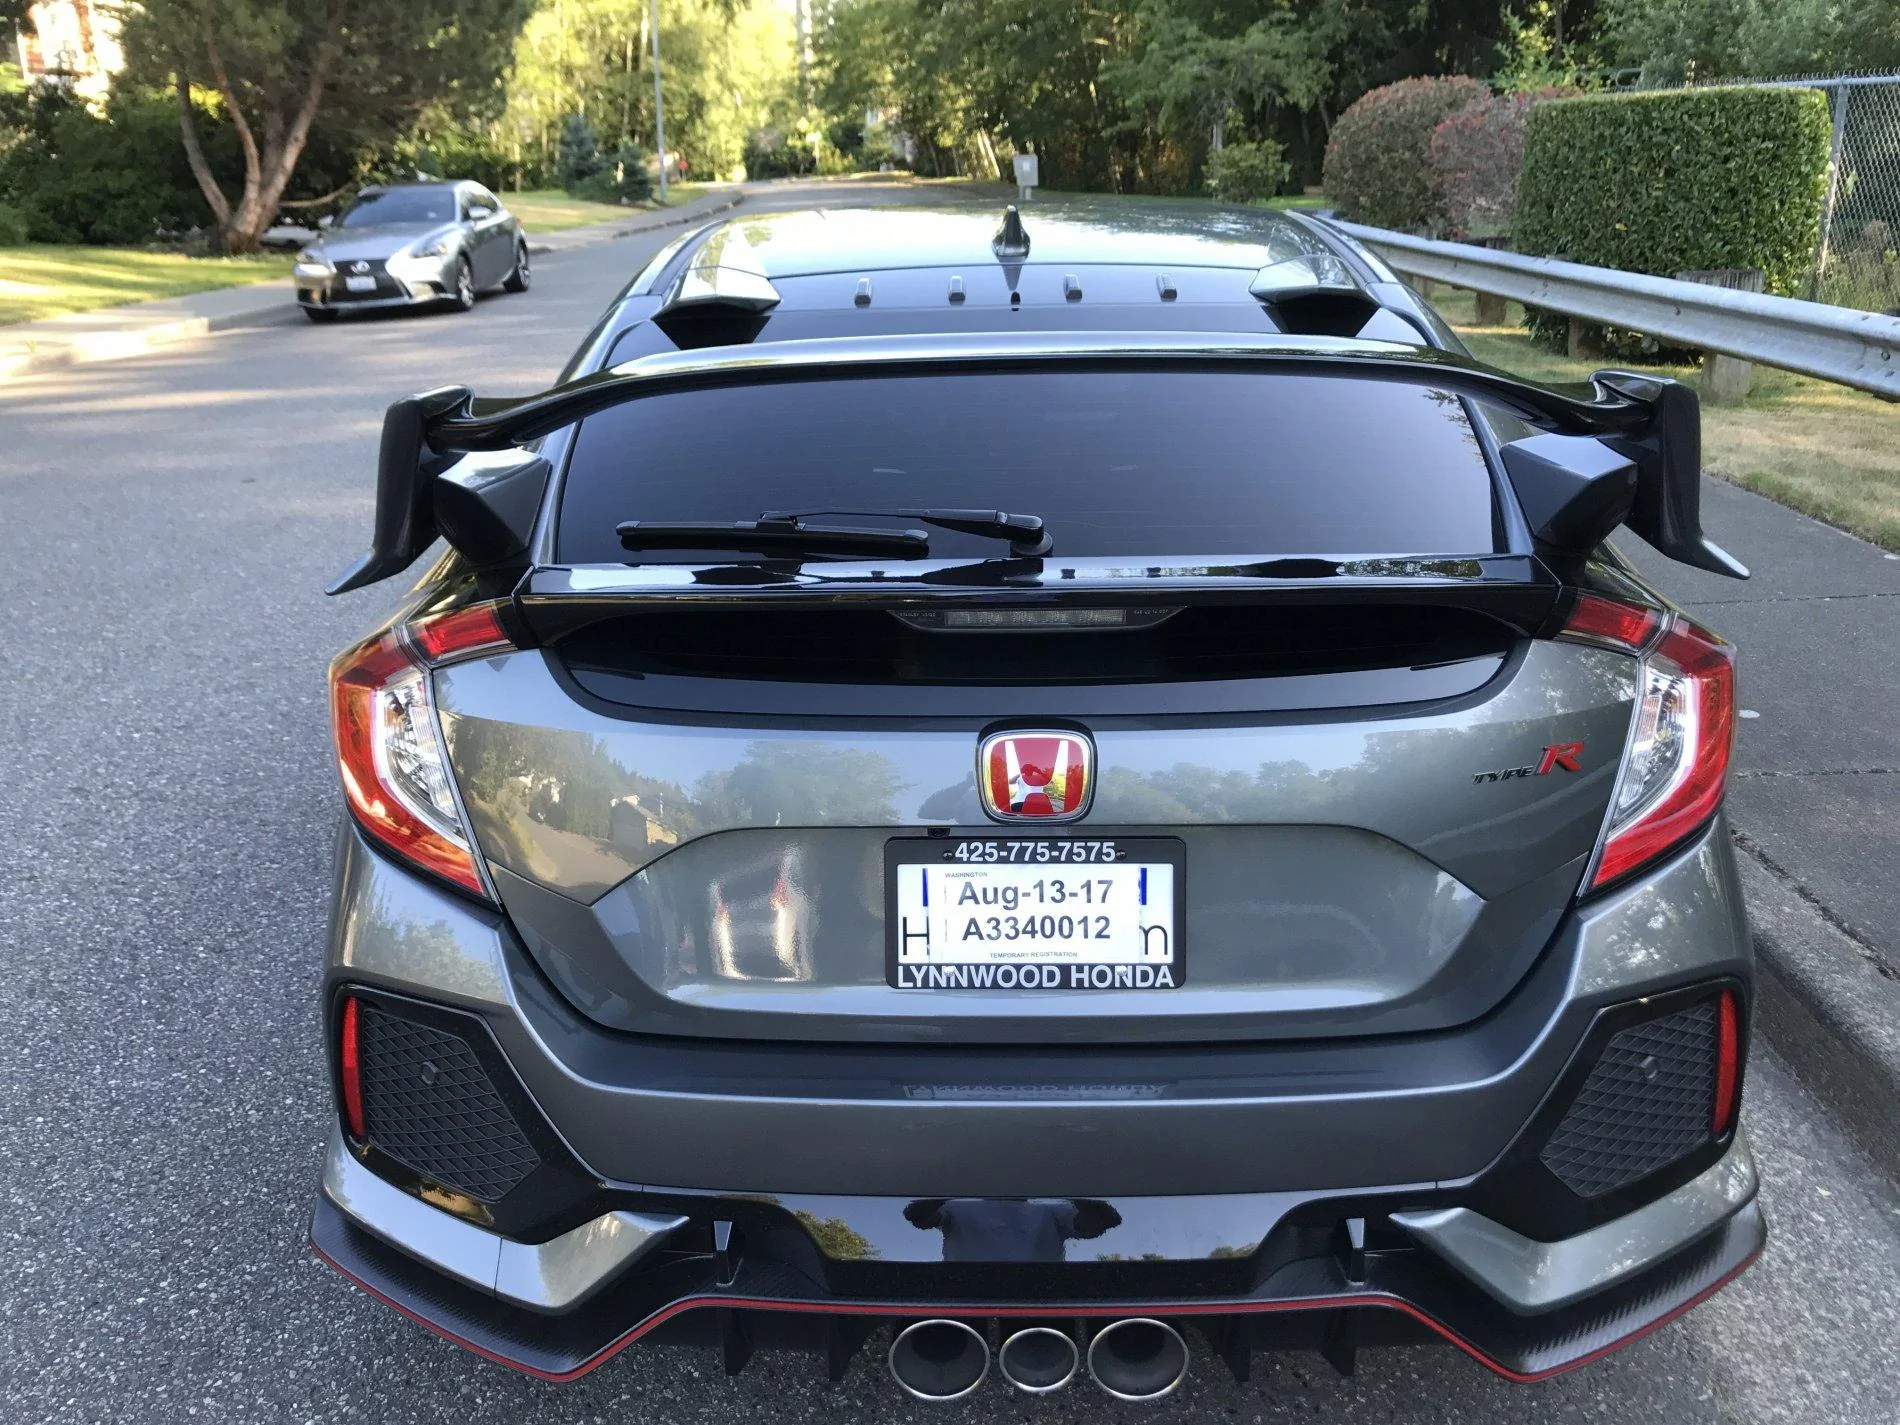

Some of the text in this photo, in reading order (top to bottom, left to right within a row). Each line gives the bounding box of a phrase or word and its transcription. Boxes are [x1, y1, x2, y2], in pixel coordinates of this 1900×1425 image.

[1472, 741, 1584, 785] TYPE R
[954, 841, 1116, 862] 425-775-7575
[957, 879, 1114, 911] Aug-13-17
[961, 915, 1111, 941] A3340012
[897, 964, 1175, 988] LYNNWOOD HONDA
